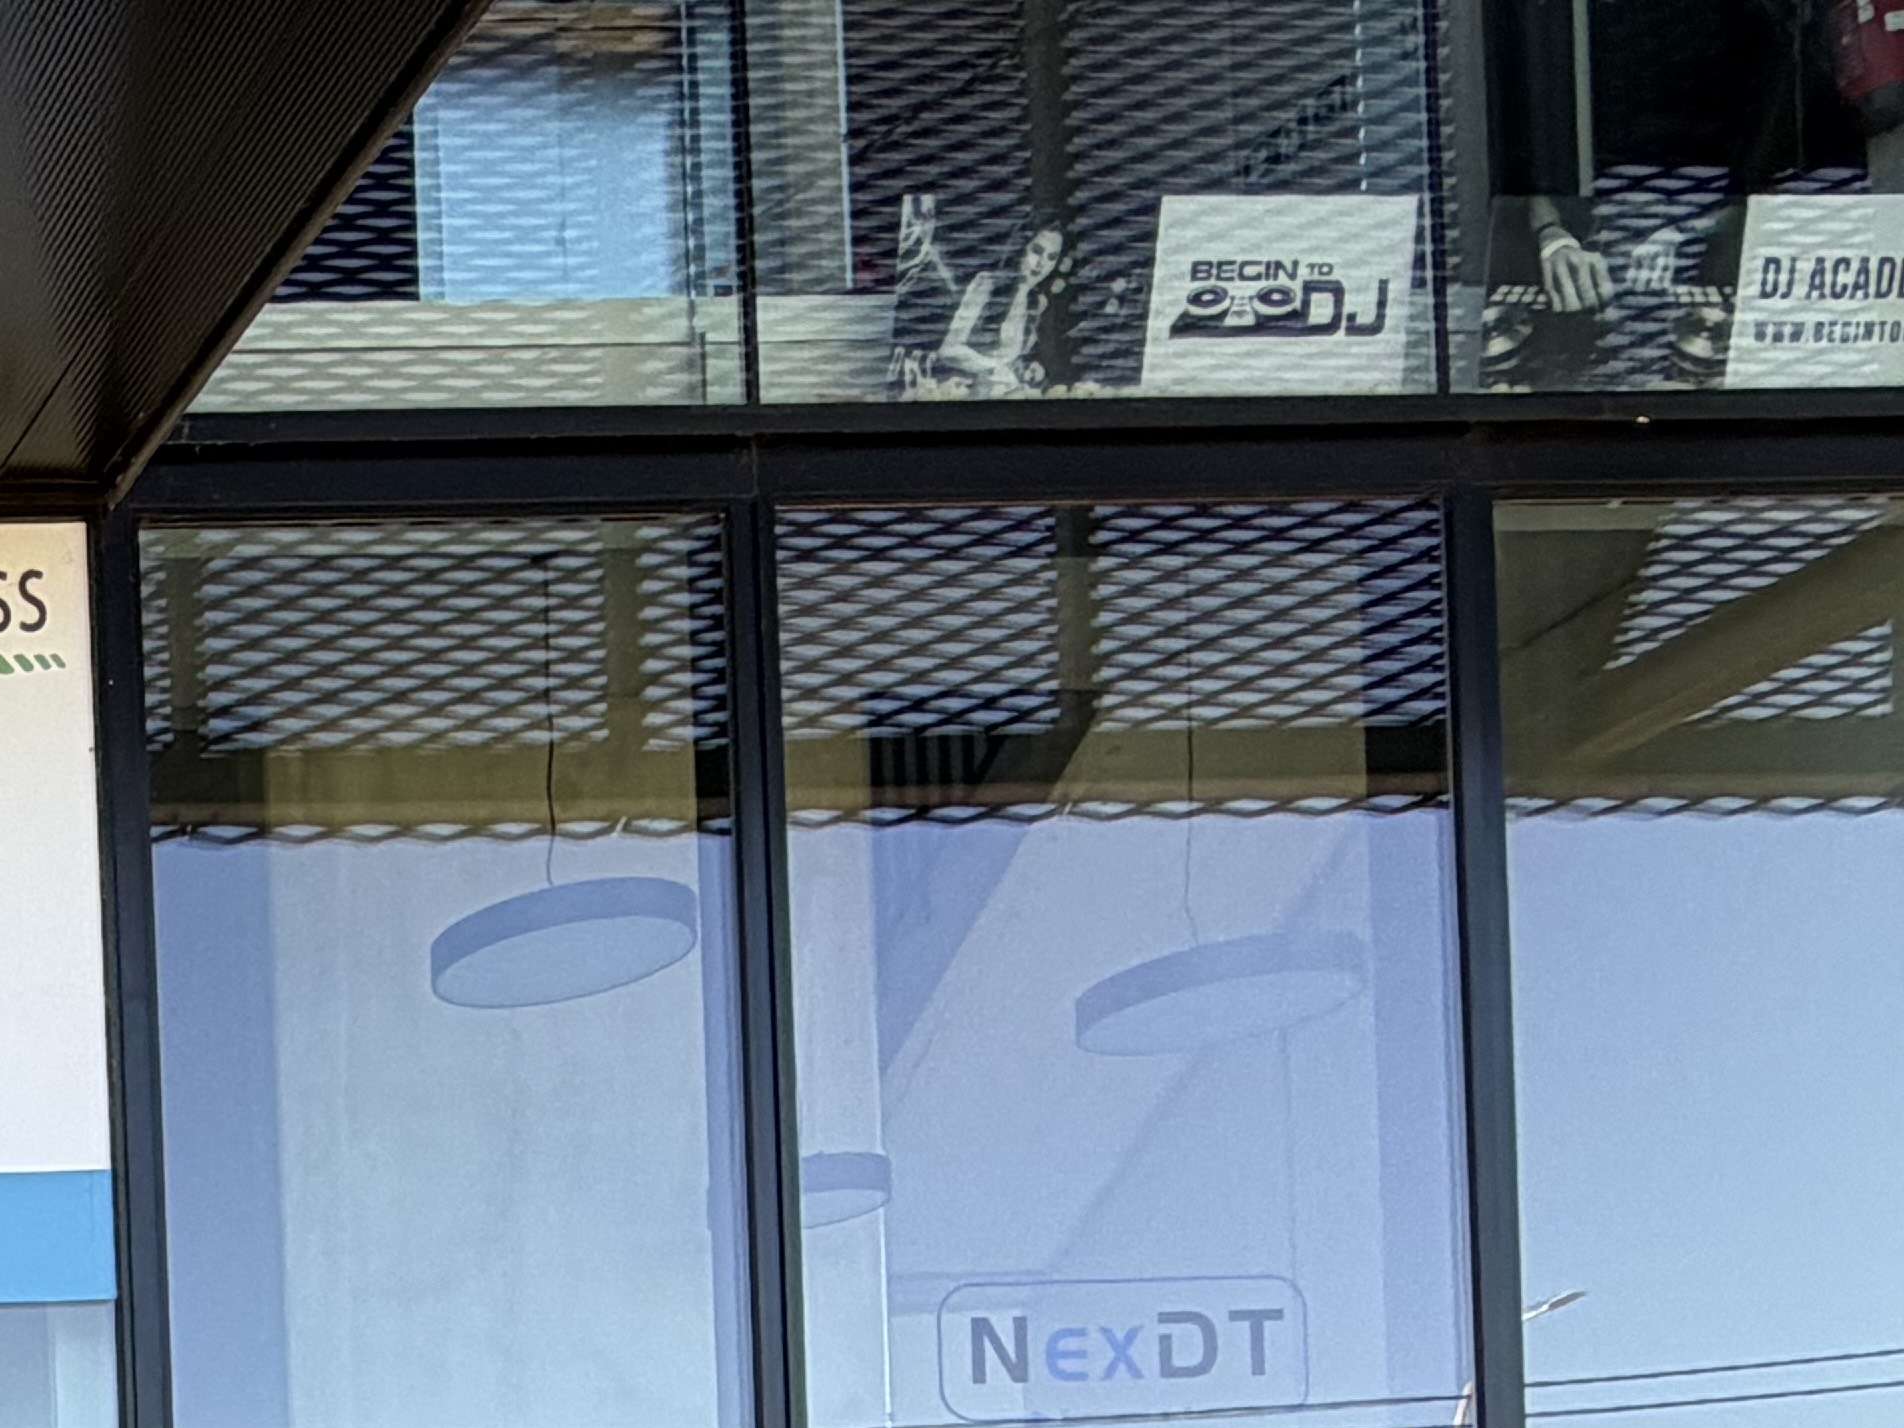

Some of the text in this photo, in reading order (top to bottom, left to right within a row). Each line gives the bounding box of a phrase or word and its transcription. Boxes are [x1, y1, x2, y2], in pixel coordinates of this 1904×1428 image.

[1190, 259, 1334, 282] BEGIN TO
[1759, 257, 1797, 301] DJ
[1300, 278, 1390, 337] DJ
[1754, 319, 1904, 344] WWW.BEGINTO
